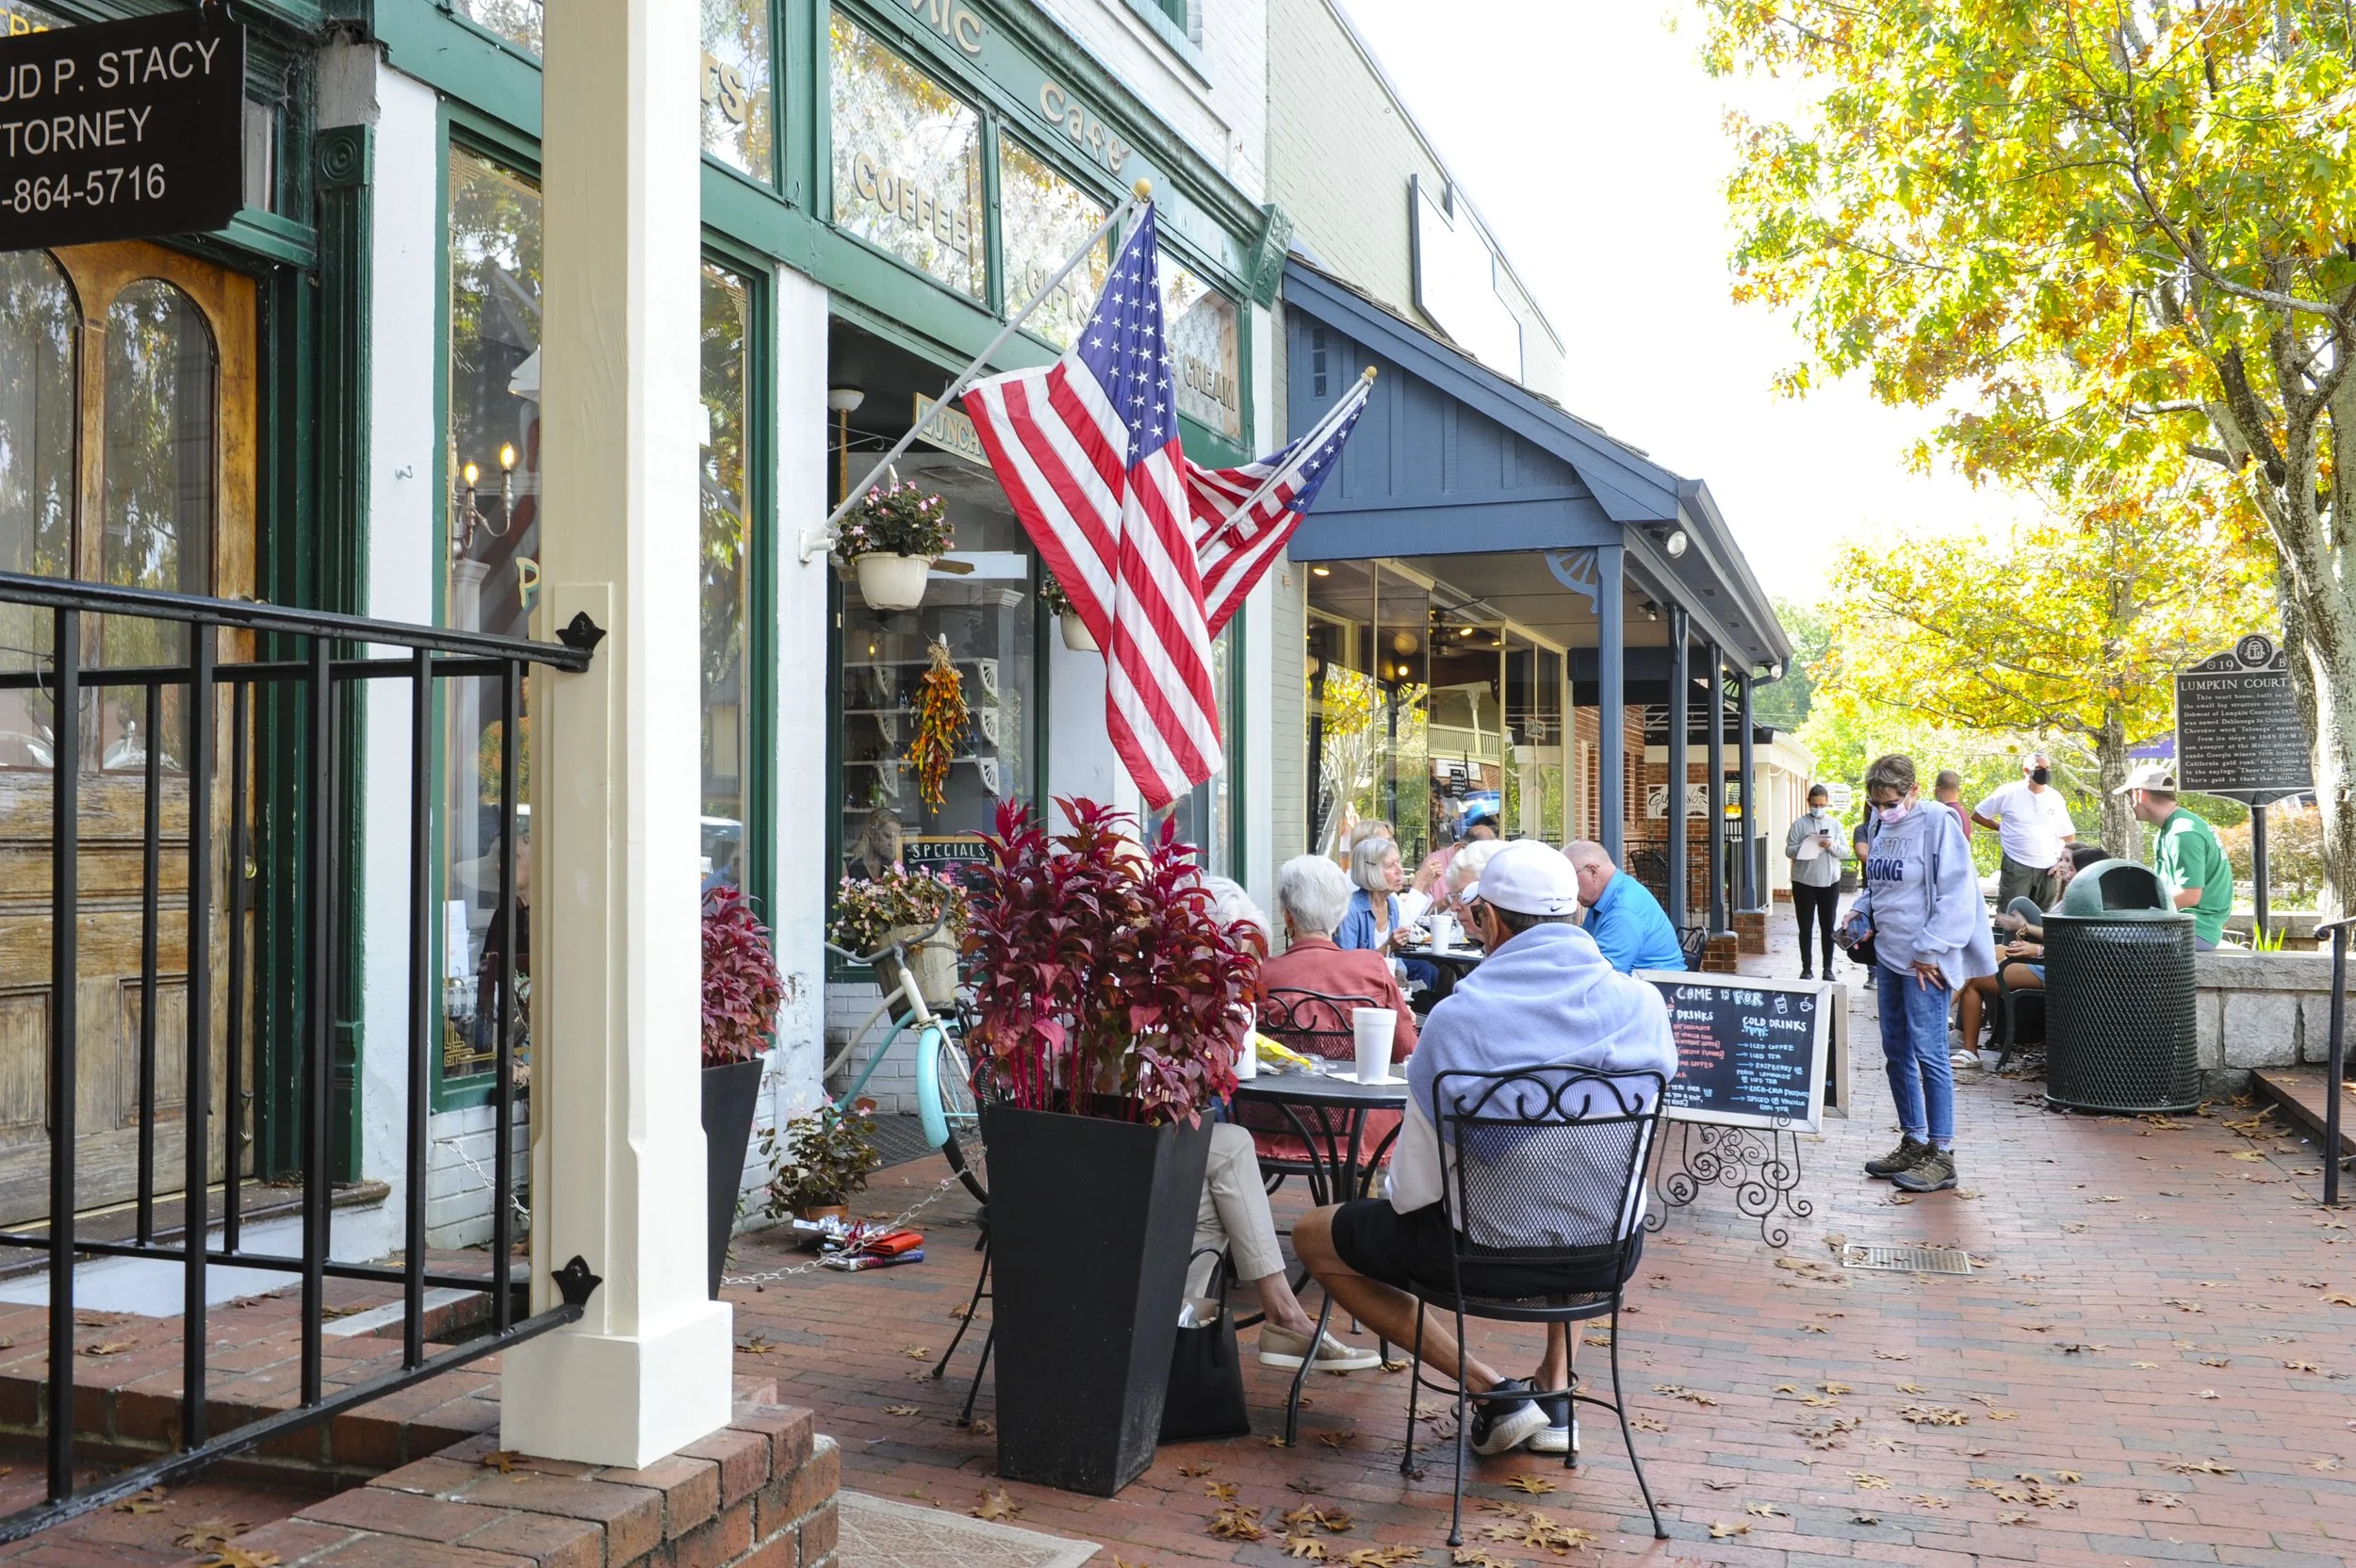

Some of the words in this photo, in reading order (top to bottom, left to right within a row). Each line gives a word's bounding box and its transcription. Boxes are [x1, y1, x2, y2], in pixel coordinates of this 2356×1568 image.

[55, 58, 84, 95] P.
[97, 38, 221, 89] STACY
[0, 106, 152, 157] TORNEY
[2, 163, 166, 214] -864-5716
[854, 152, 969, 256] COFFEE
[1026, 254, 1091, 328] GIFTS
[1183, 351, 1235, 412] CREAM
[2180, 678, 2238, 692] LUMPKIN
[2243, 677, 2288, 689] COURT
[912, 843, 986, 858] SPECIALS
[1868, 858, 1904, 882] RONG
[1677, 986, 1713, 1001] COME
[1732, 989, 1764, 1006] FOR
[1677, 1009, 1714, 1022] DRINKS
[1742, 1016, 1766, 1027] COLD
[1769, 1019, 1808, 1032] DRINKS
[1755, 1062, 1792, 1073] RASPBERRY
[1759, 1071, 1792, 1080] LEMONADE
[1749, 1086, 1783, 1094] COCA-COLA
[1746, 1095, 1770, 1103] SPICED
[1781, 1098, 1806, 1106] VANILLA
